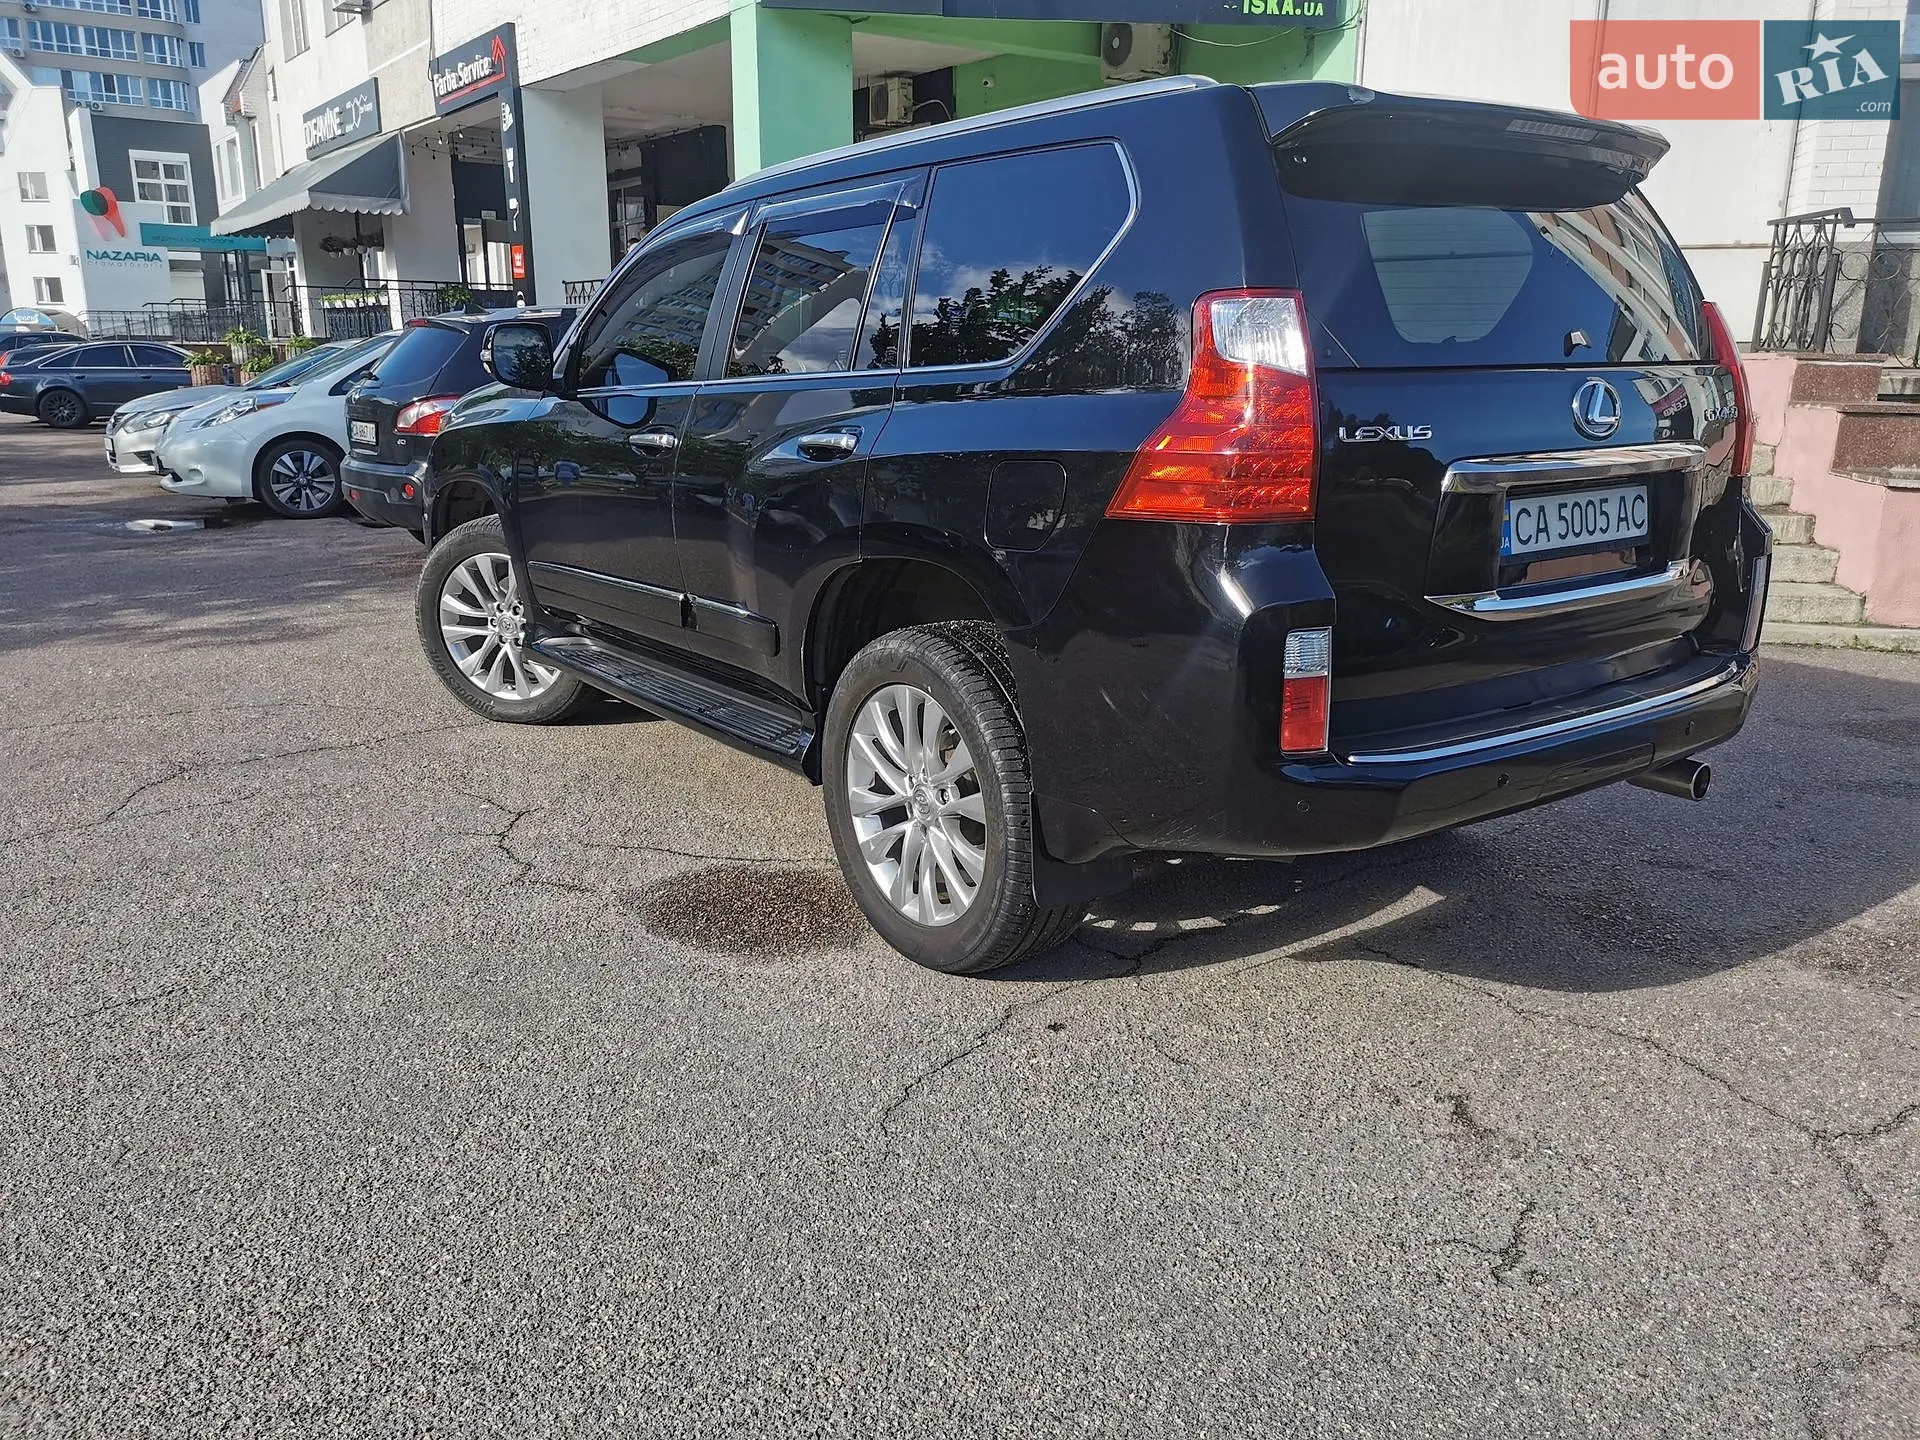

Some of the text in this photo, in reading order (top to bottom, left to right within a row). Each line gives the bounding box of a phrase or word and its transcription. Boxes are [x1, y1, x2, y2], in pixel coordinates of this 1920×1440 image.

[86, 249, 162, 262] NAZARIA
[1338, 425, 1432, 442] LEXUS
[1516, 494, 1645, 545] CA 5005 AC
